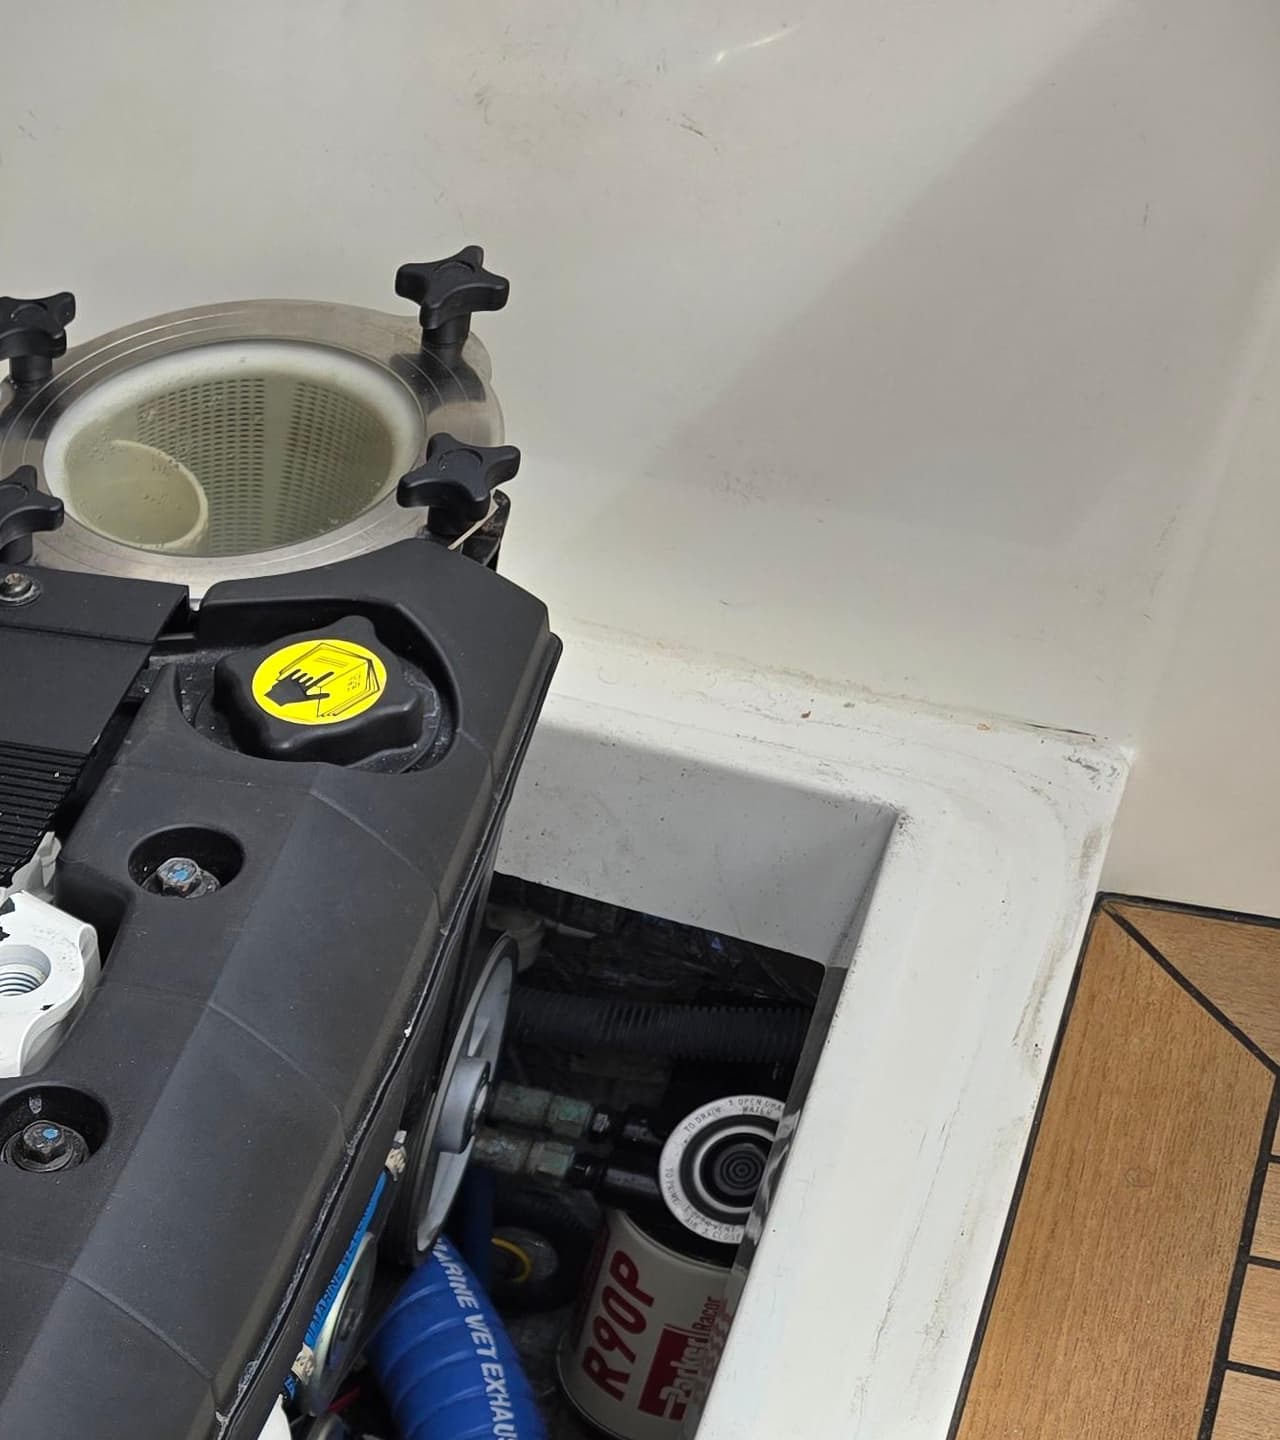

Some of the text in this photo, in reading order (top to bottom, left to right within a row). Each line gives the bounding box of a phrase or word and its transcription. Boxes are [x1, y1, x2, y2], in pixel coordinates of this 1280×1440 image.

[464, 1314, 497, 1360] WET
[582, 1250, 654, 1401] R90P
[692, 1296, 721, 1332] Racor
